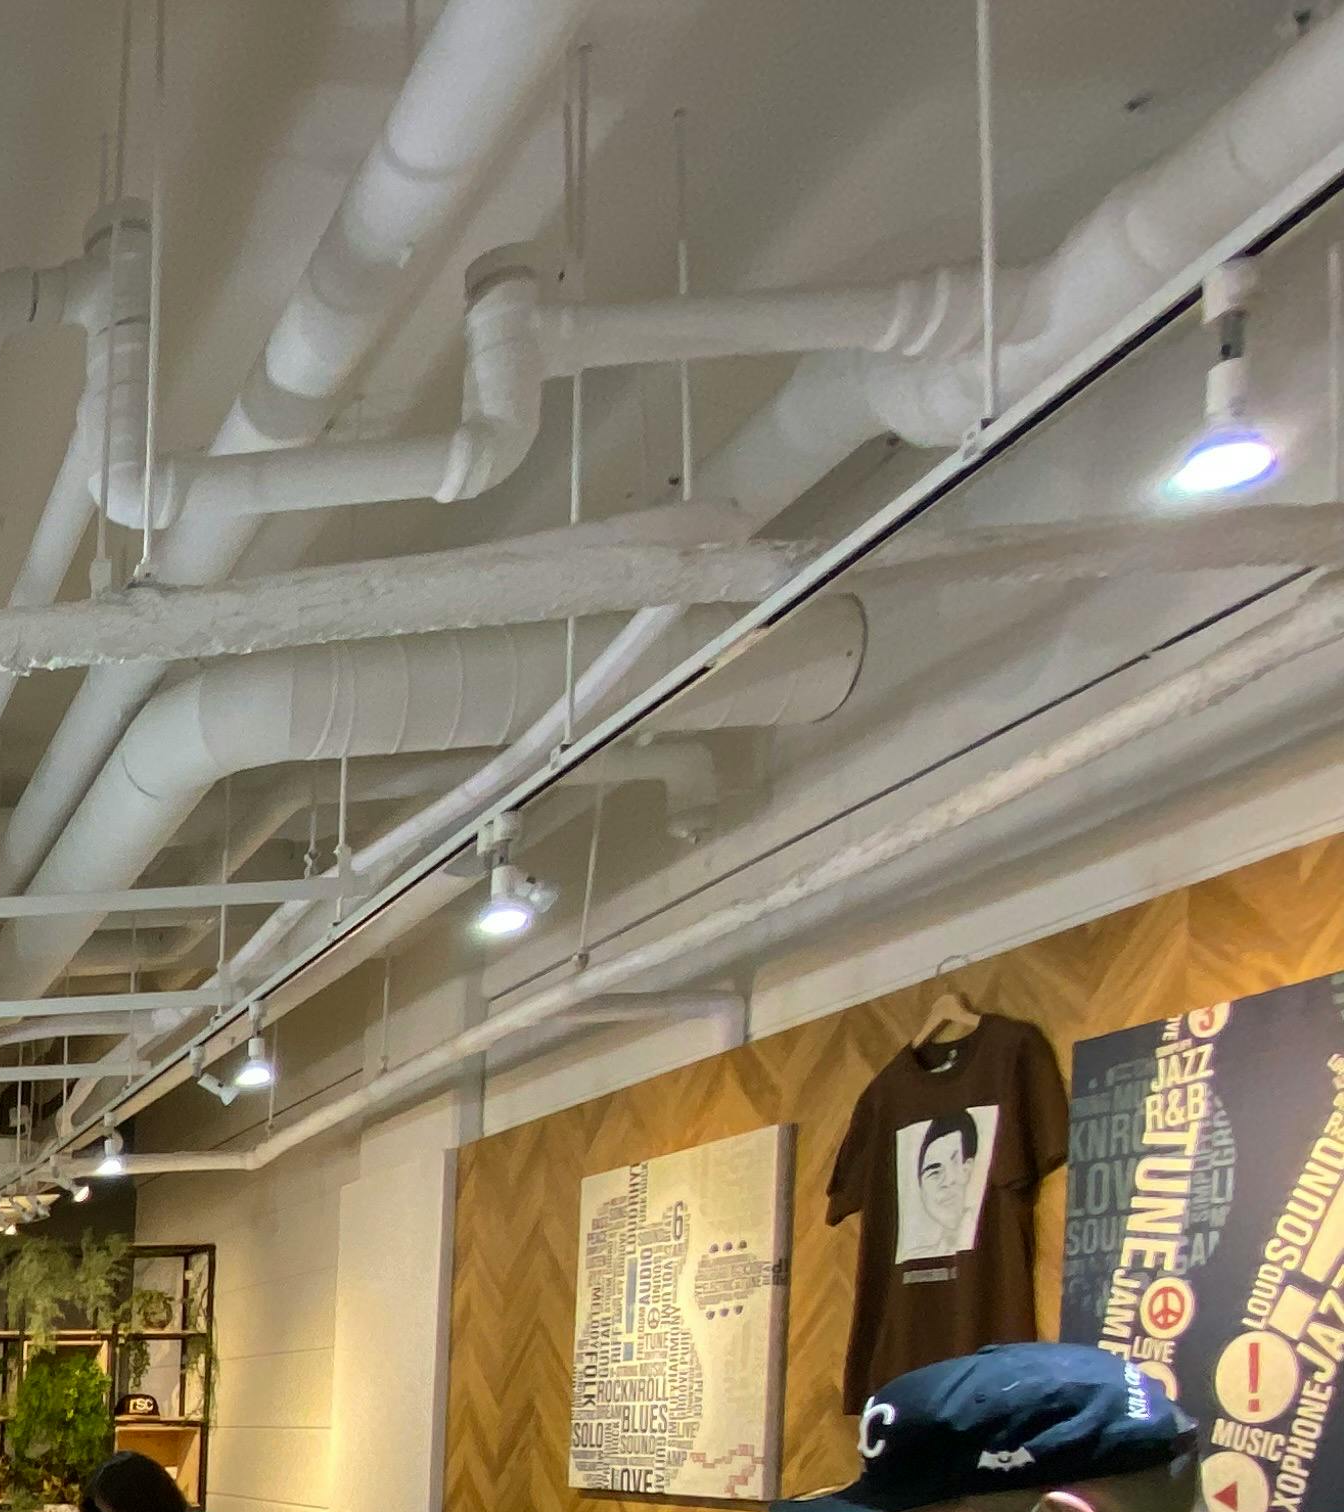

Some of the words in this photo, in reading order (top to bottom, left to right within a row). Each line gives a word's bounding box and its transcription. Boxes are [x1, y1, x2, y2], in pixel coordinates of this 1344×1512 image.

[1151, 1043, 1214, 1092] JAZZ
[1145, 1083, 1207, 1132] R&B
[1120, 1121, 1201, 1272] TUNE
[1265, 1137, 1344, 1271] SOUND
[638, 1247, 653, 1306] AUDIO
[1242, 1264, 1285, 1330] LOUD
[1102, 1269, 1141, 1340] JAM
[1132, 1335, 1177, 1364] LOVE
[583, 1351, 598, 1407] FOLK
[596, 1375, 669, 1403] ROCKNROLL
[572, 1421, 604, 1448] SOLO
[621, 1403, 668, 1434] BLUES
[1210, 1418, 1286, 1462] MUSIC
